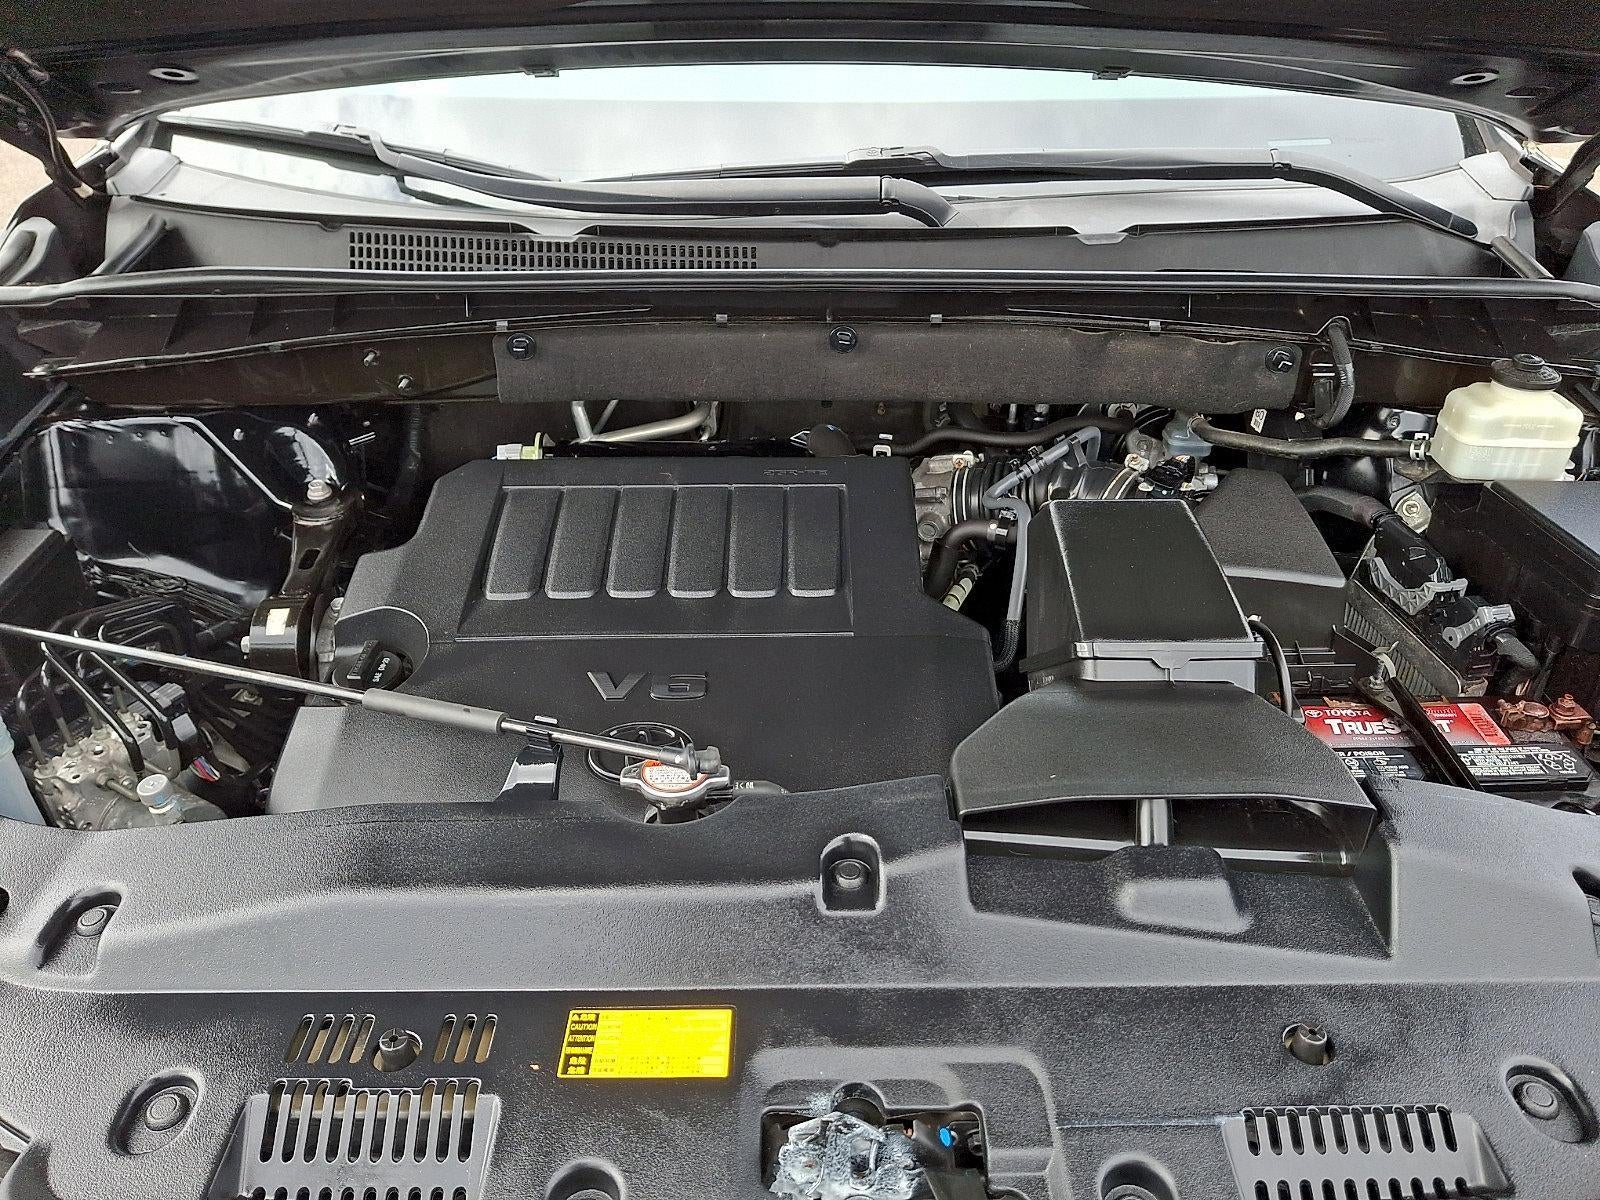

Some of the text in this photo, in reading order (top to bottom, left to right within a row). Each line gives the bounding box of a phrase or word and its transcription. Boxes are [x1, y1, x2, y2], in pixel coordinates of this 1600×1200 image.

[586, 671, 708, 701] V6
[1323, 708, 1372, 718] TOYOTA
[570, 1023, 597, 1031] CAUTION
[567, 1034, 596, 1043] ATTENTION
